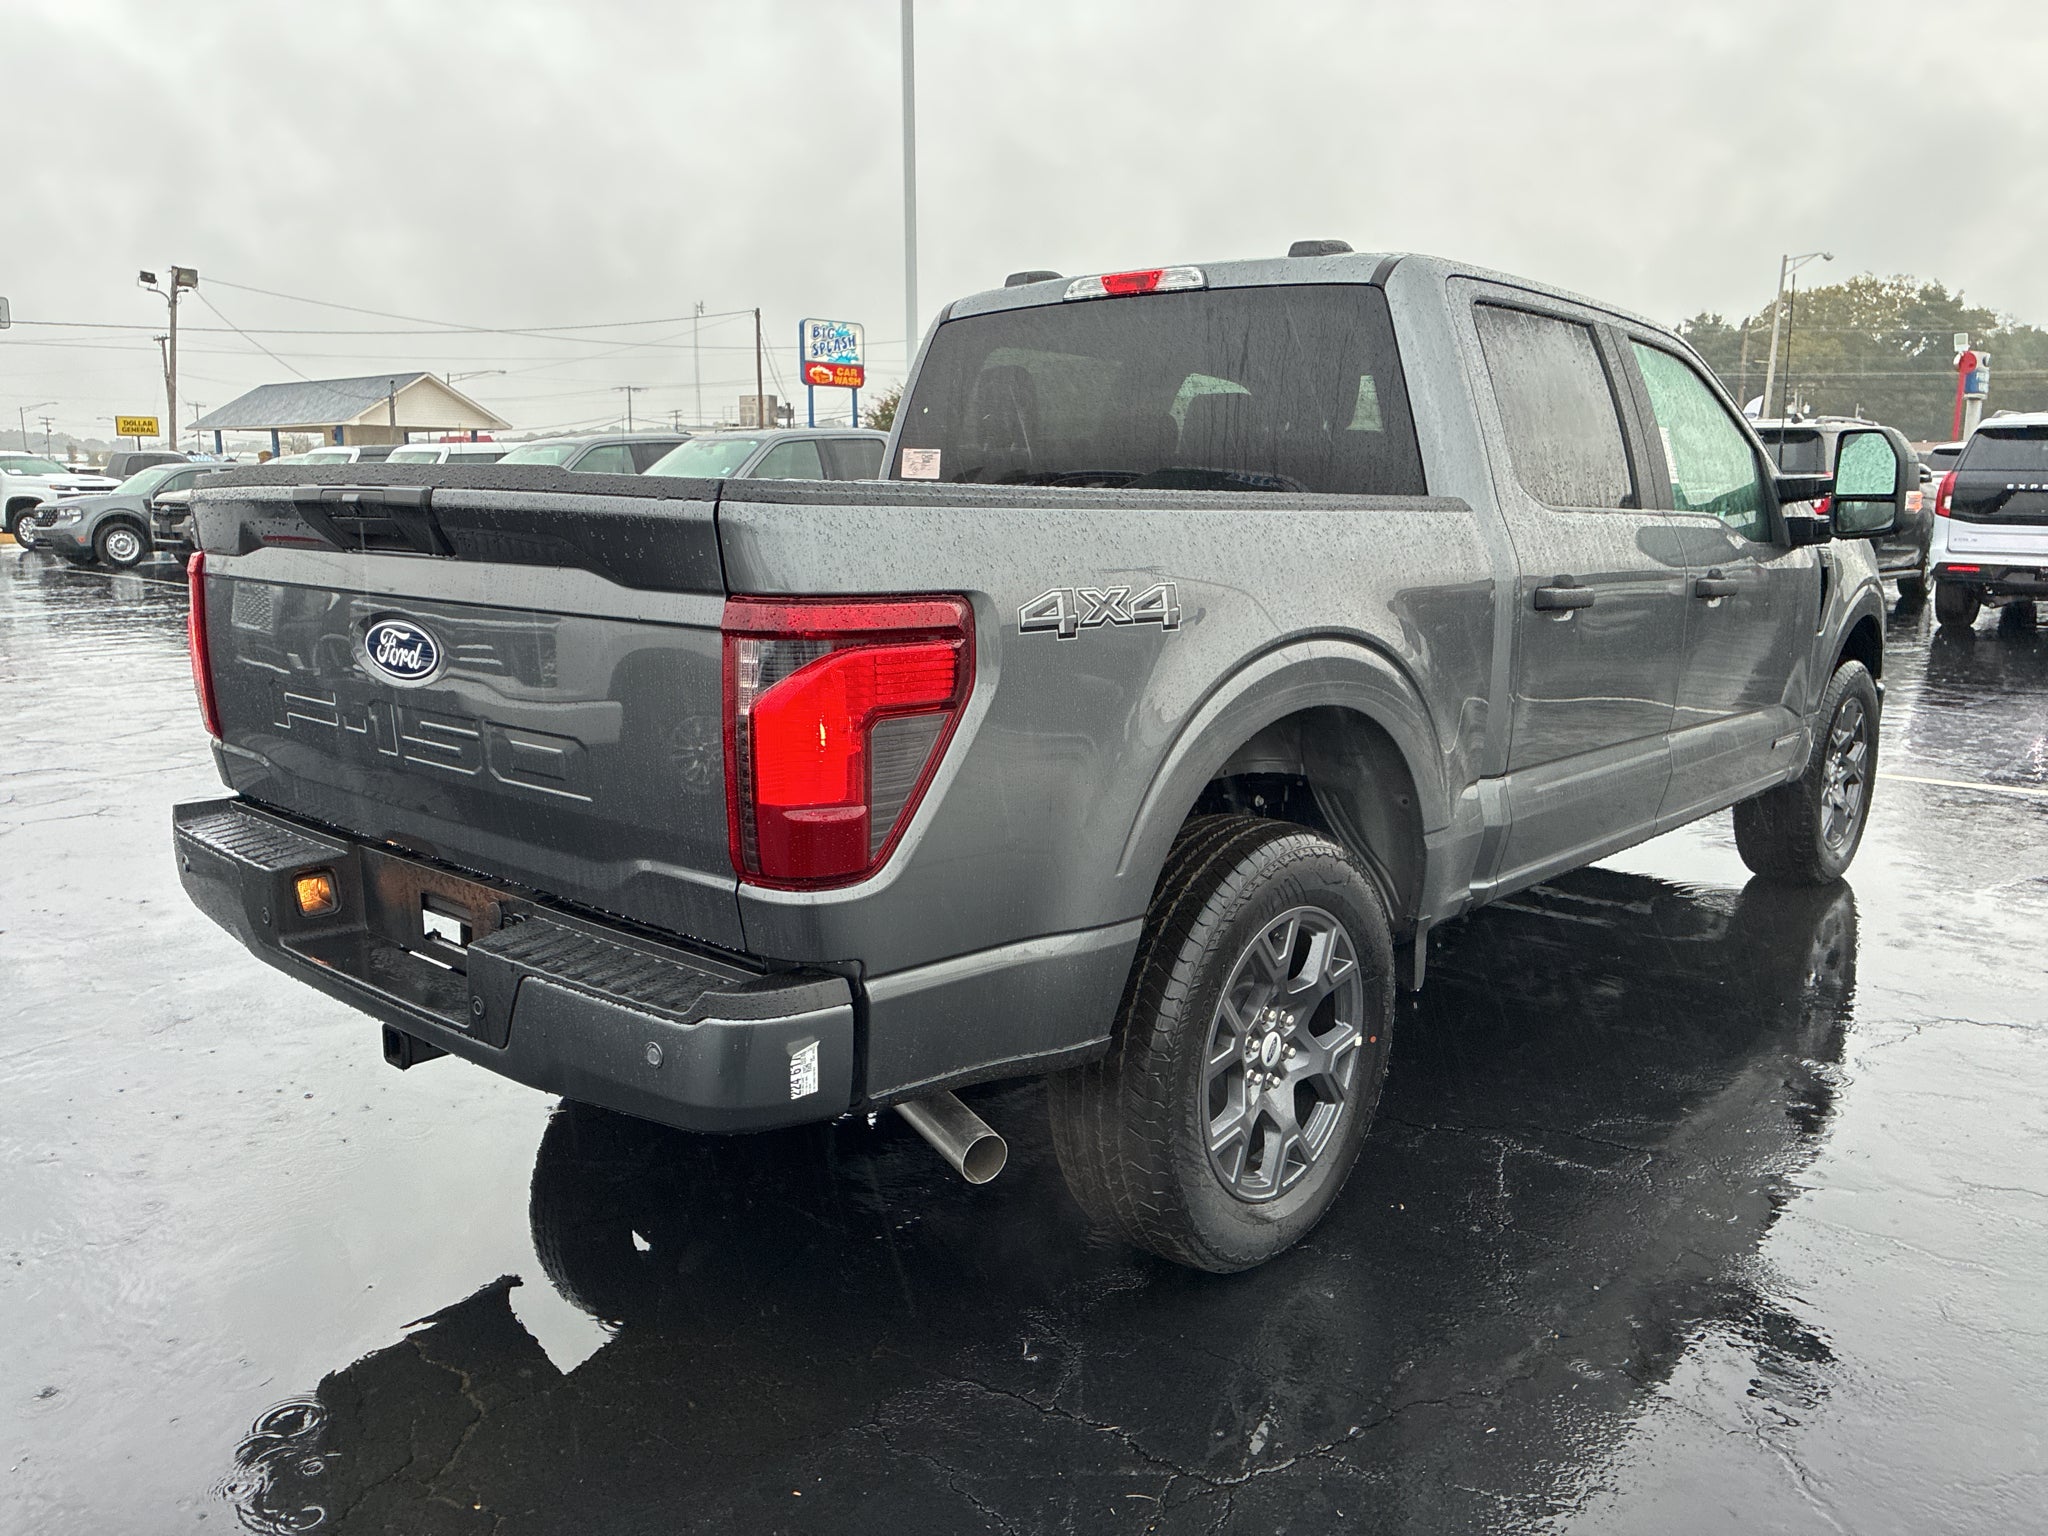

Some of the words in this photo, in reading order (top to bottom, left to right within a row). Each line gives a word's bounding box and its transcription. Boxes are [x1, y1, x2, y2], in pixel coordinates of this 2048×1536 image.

[812, 325, 835, 340] BIG
[812, 335, 856, 356] SPLASH
[834, 376, 861, 385] WASH
[836, 367, 858, 377] CAR
[376, 628, 422, 669] Ford
[272, 680, 593, 802] F-150
